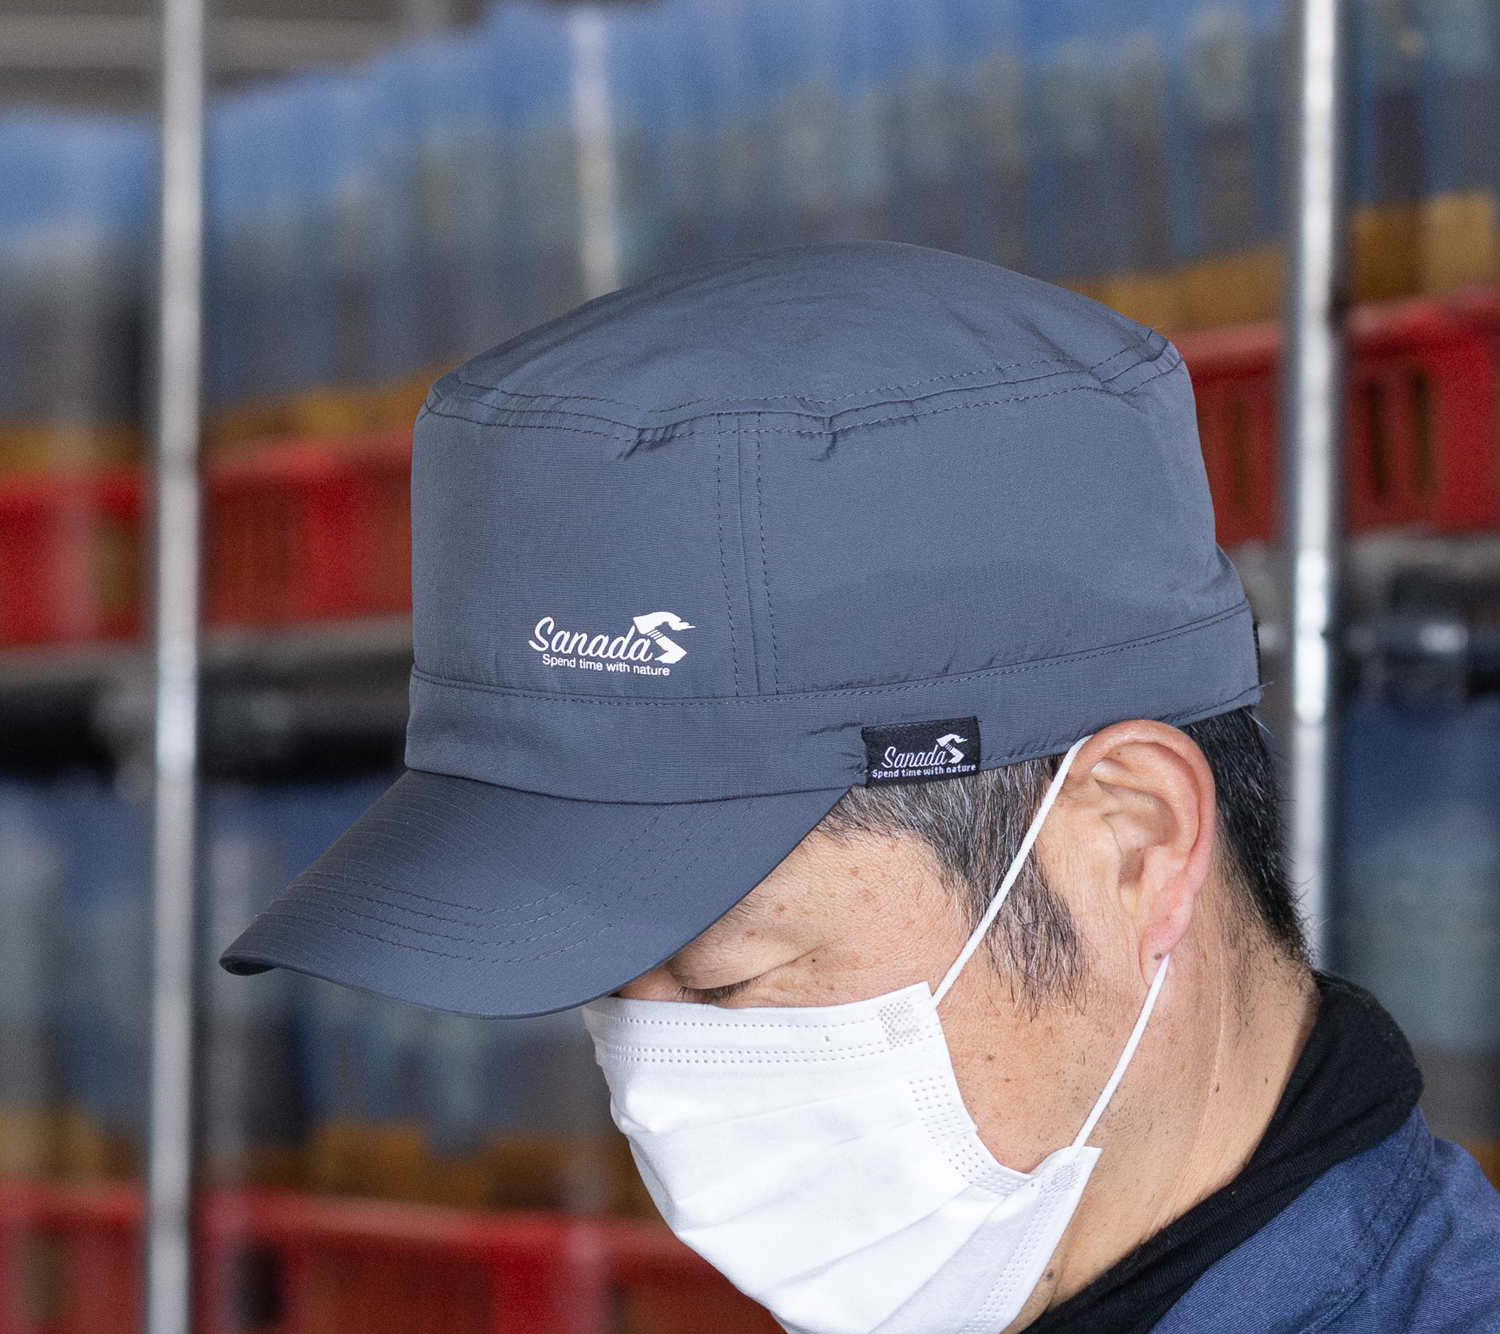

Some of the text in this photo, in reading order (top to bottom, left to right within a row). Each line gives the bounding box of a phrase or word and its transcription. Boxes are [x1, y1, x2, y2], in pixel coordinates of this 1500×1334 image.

[528, 616, 653, 662] Sanada
[542, 653, 670, 676] Spend time with nature
[881, 744, 947, 768] Sanada
[872, 764, 976, 779] Spend time with nature
